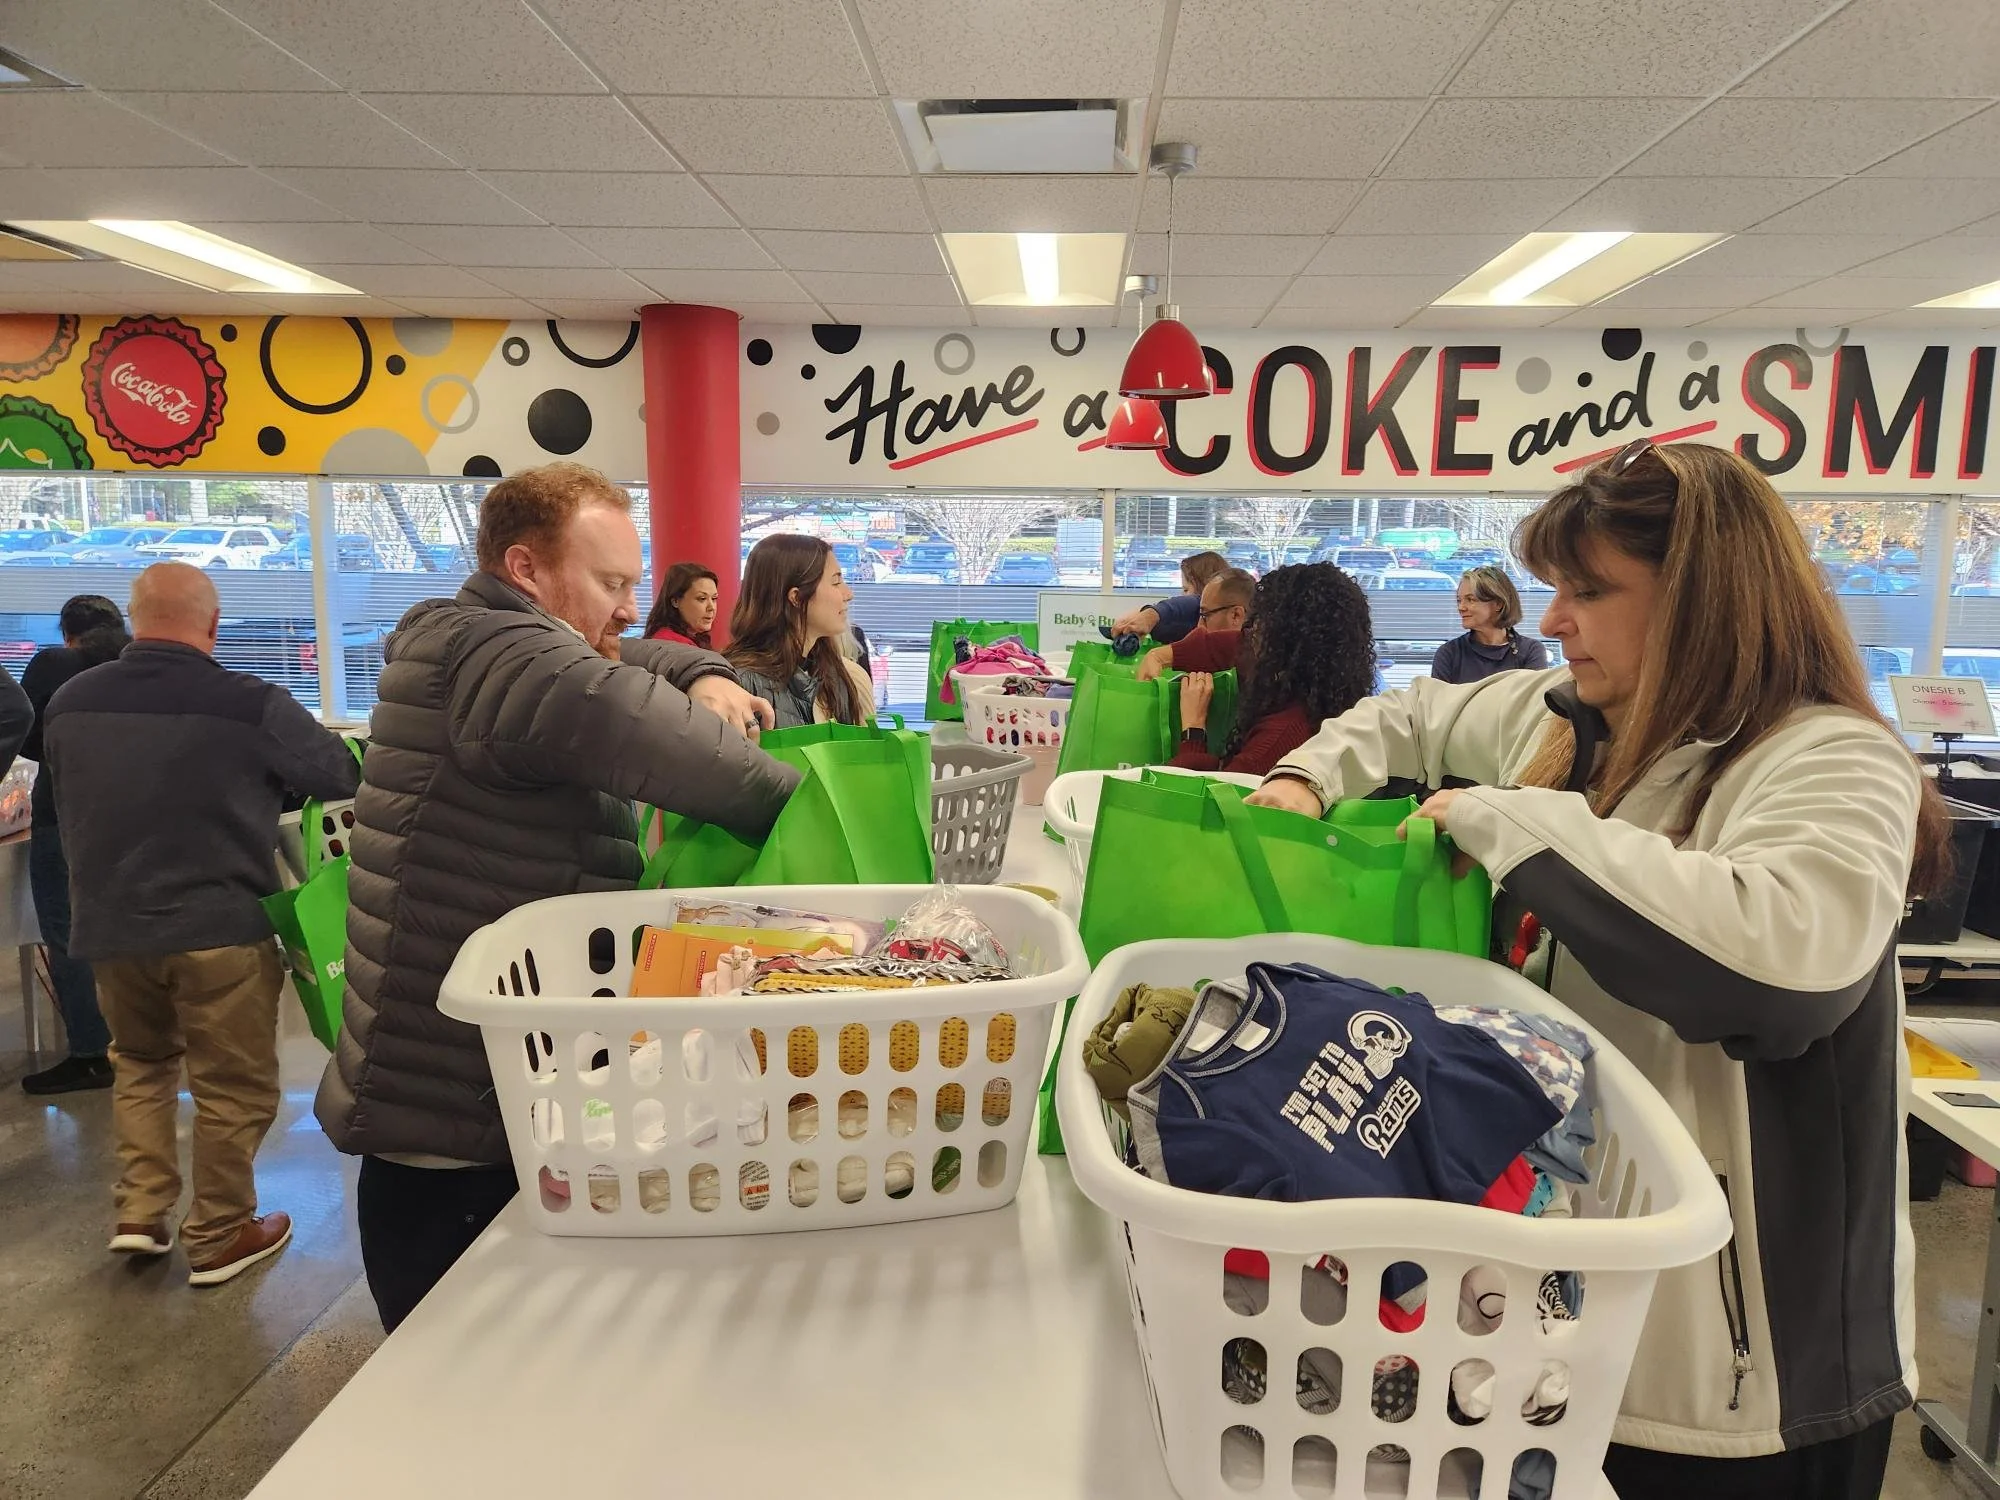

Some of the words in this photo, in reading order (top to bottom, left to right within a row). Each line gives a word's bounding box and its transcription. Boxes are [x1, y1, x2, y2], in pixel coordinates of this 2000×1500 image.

[825, 360, 1044, 464] Have
[1063, 390, 1109, 437] a
[1156, 345, 1501, 476] COKE
[1508, 352, 1655, 465] and
[1679, 365, 1720, 411] a
[1735, 344, 1997, 479] SMI
[1055, 613, 1086, 627] Baby
[1912, 685, 1955, 695] ONESIE
[1298, 1053, 1374, 1153] PLAY
[1300, 1060, 1330, 1097] SET
[1318, 1041, 1346, 1066] TO
[1358, 1079, 1421, 1159] Rams
